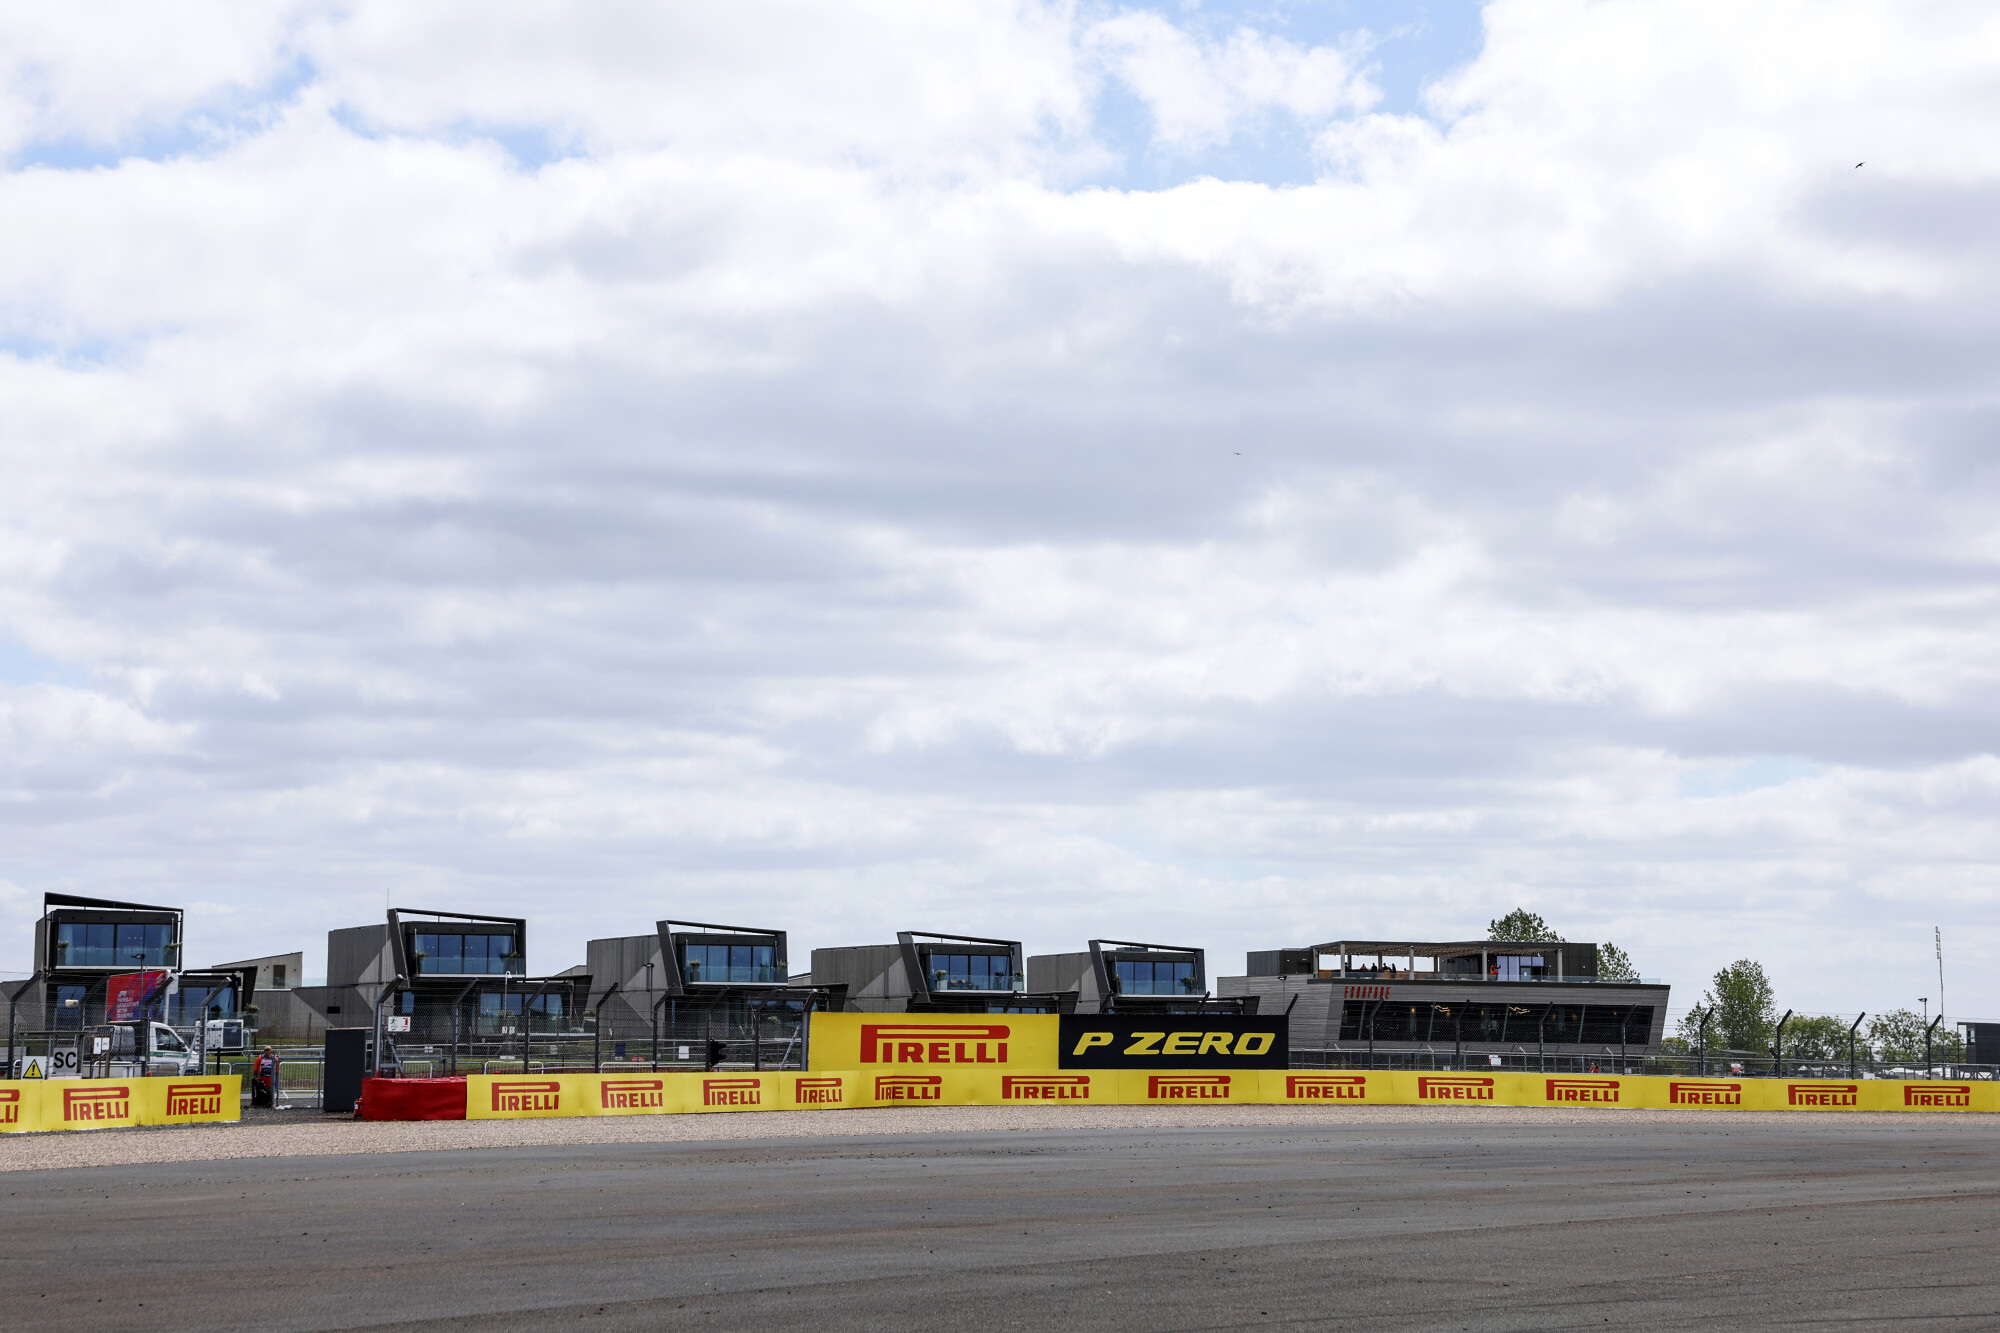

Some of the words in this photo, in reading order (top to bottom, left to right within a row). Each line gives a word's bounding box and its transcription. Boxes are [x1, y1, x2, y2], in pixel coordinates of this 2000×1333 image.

[860, 1024, 1010, 1063] PIRELLI
[1073, 1032, 1114, 1055] P
[1123, 1032, 1275, 1055] ZERO
[53, 1052, 77, 1068] SC
[491, 1082, 560, 1111] PIRELLI
[601, 1080, 663, 1108] PIRELLI
[703, 1079, 760, 1106] PIRELLI
[796, 1078, 842, 1103] PIRELLI
[875, 1076, 942, 1100] PIRELLI
[1002, 1076, 1090, 1099] PIRELLI
[1149, 1076, 1231, 1099] PIRELLI
[1286, 1076, 1366, 1099] PIRELLI
[1418, 1077, 1494, 1100] PIRELLI
[1546, 1079, 1620, 1102] PIRELLI
[1670, 1083, 1742, 1105] PIRELLI
[1788, 1085, 1858, 1106] PIRELLI
[1904, 1086, 1971, 1107] PIRELLI
[64, 1087, 129, 1121] PIRELLI
[166, 1083, 222, 1116] PIRELLI
